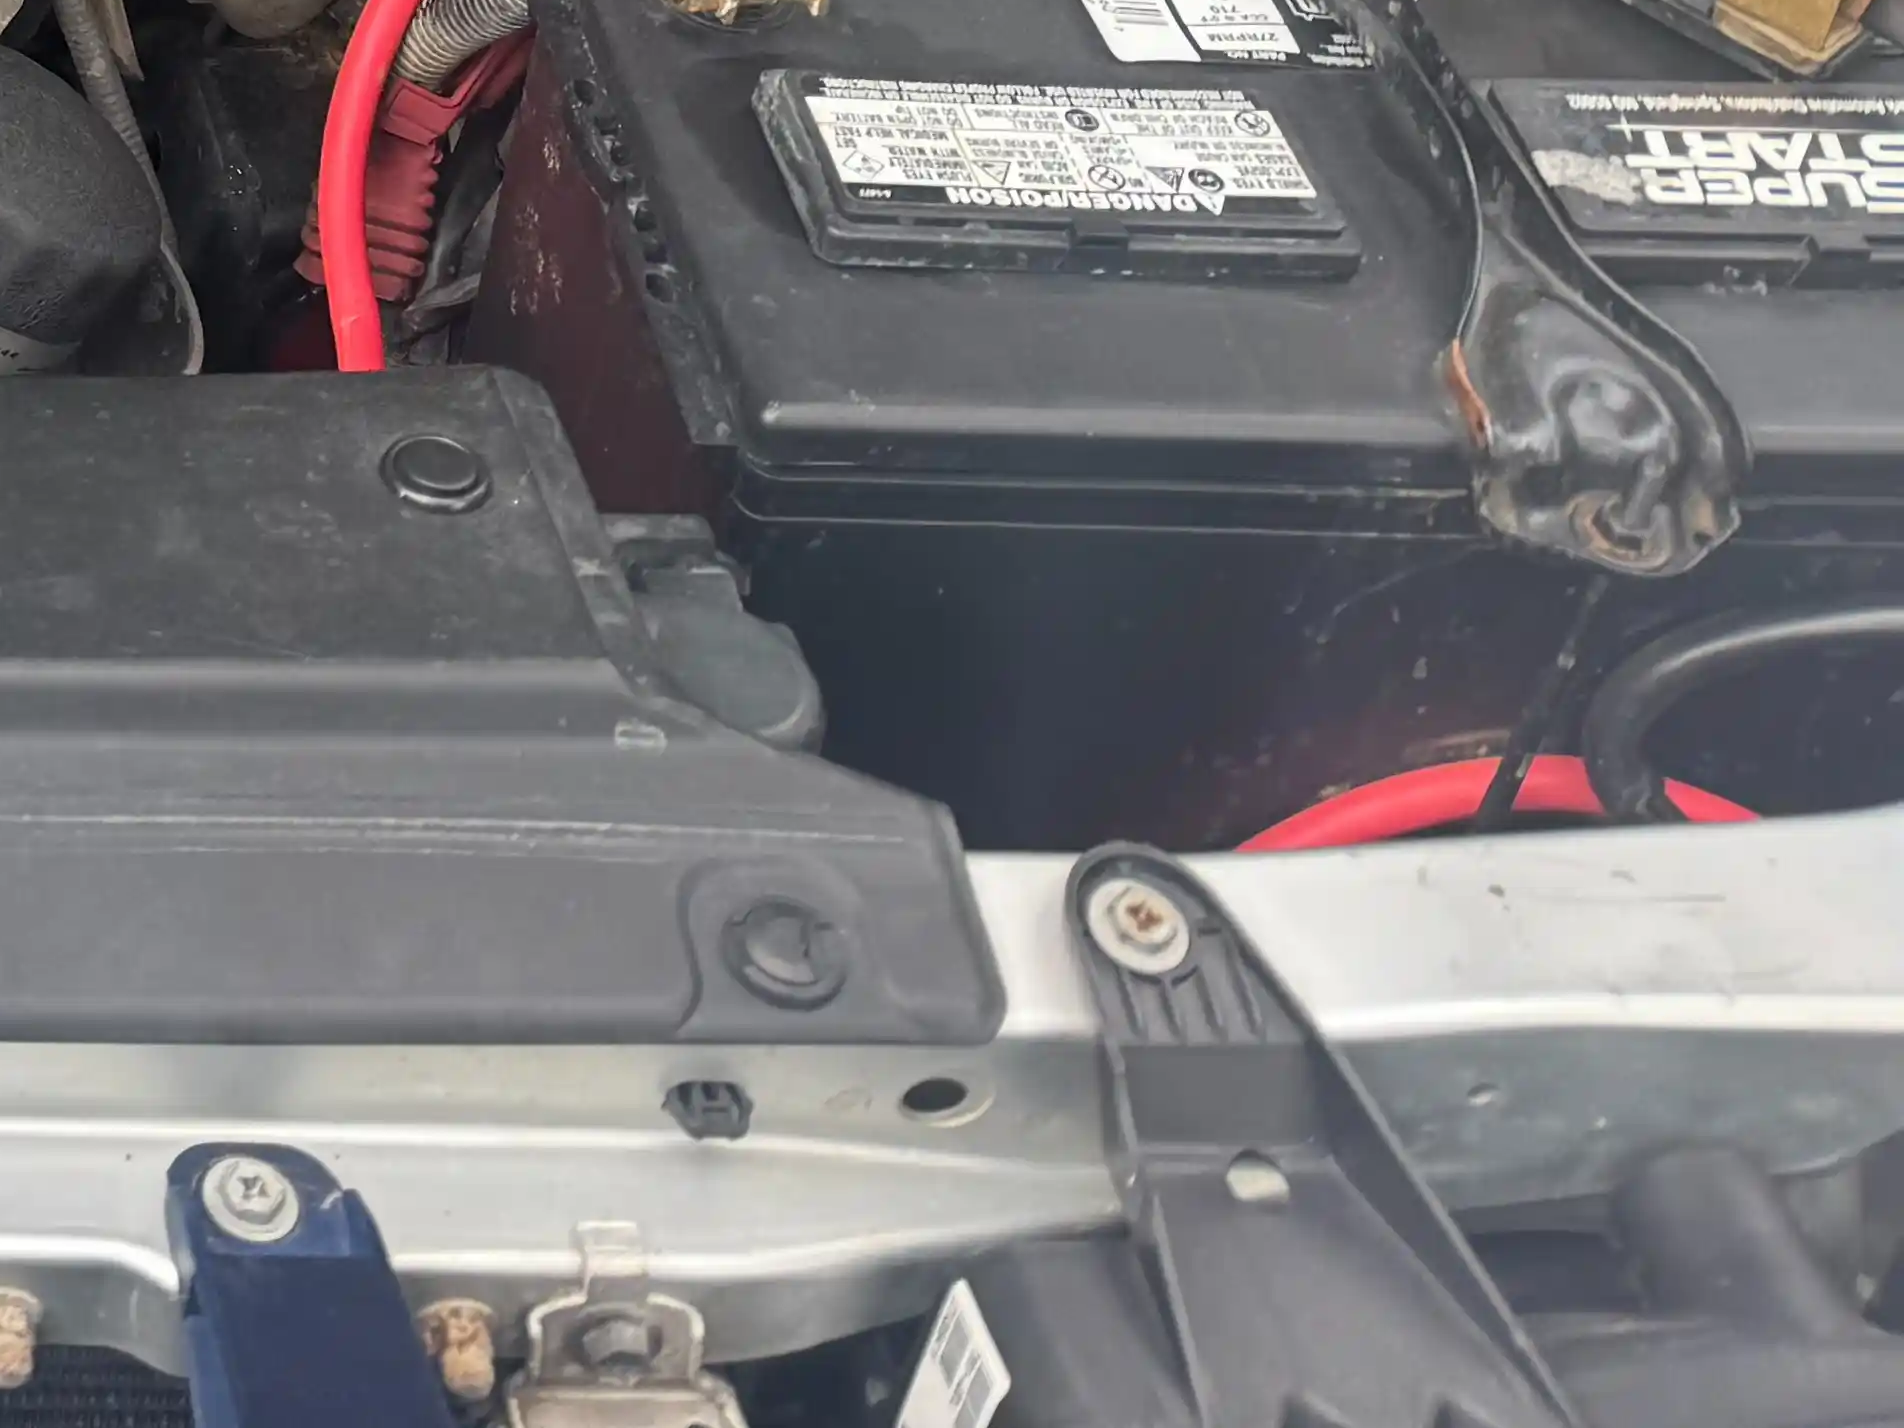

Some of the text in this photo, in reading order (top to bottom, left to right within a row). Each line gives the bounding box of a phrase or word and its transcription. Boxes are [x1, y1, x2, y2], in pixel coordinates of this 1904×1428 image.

[1625, 129, 1904, 171] START
[945, 186, 1197, 212] DANGER/POISON
[1640, 167, 1904, 214] SUPER
